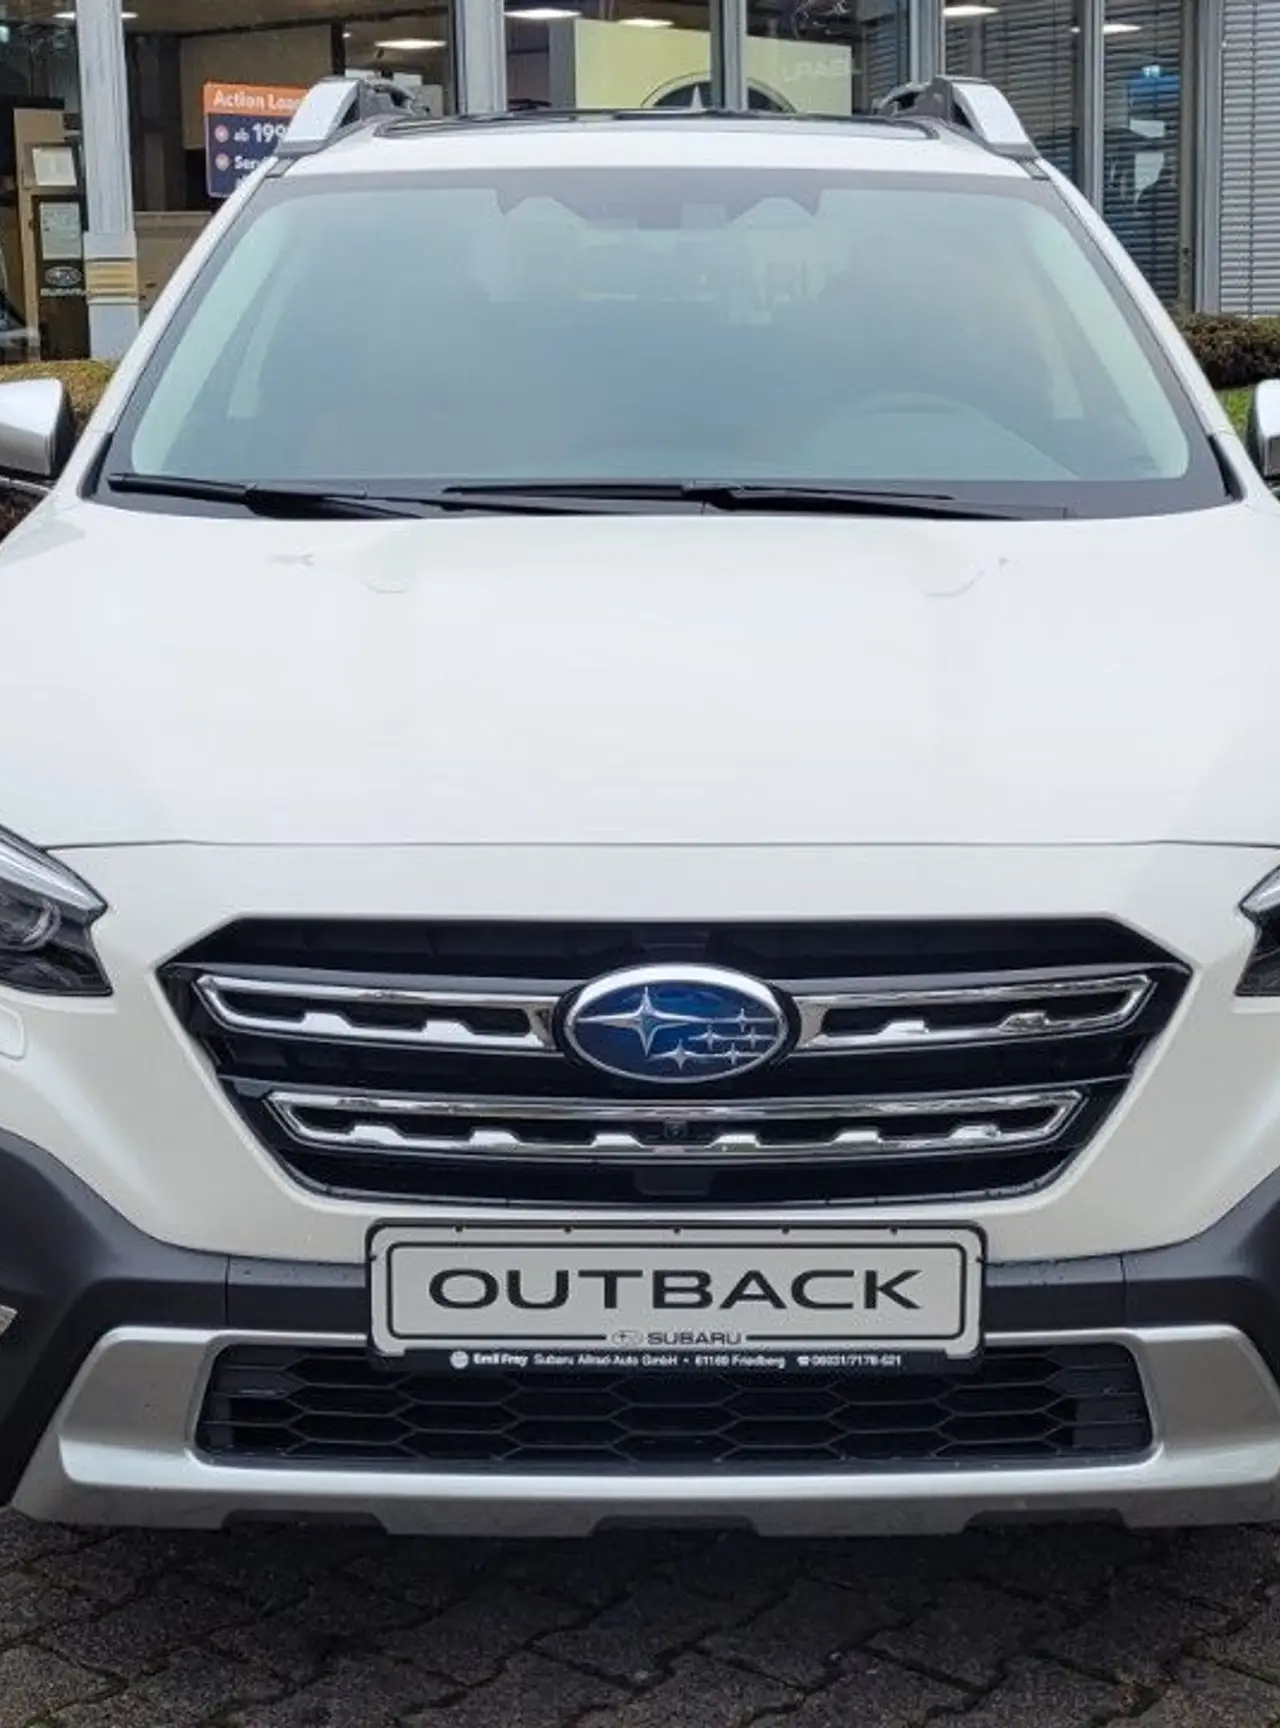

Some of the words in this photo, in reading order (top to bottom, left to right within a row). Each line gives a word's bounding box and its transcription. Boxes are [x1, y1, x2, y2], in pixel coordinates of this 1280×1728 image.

[213, 90, 265, 110] Action
[428, 1269, 923, 1310] OUTBACK
[647, 1332, 741, 1345] SUBARU
[473, 1353, 499, 1365] Emil
[534, 1353, 574, 1366] Subaru
[642, 1354, 678, 1366] GmbH
